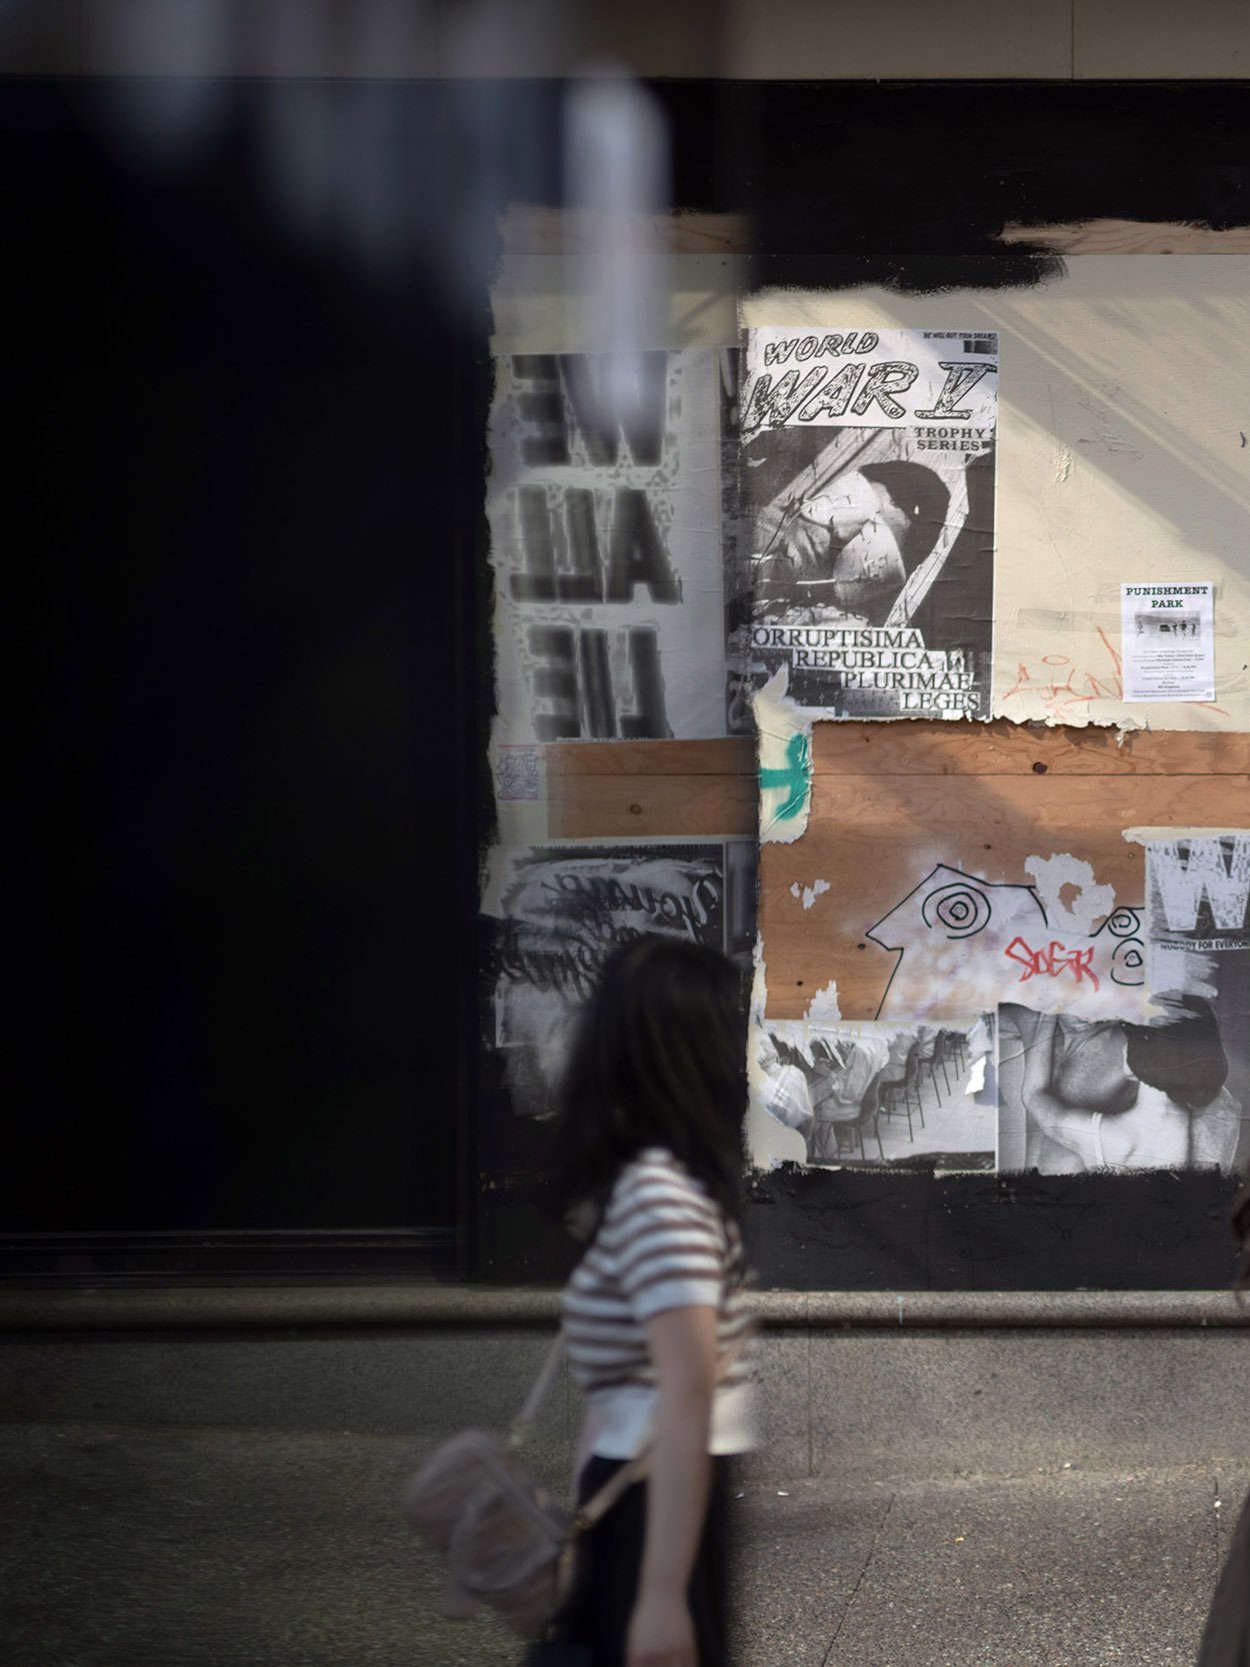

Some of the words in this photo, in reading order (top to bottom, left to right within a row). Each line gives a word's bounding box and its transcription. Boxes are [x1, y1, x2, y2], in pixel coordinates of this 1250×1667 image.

[764, 332, 879, 366] WORLD
[740, 361, 918, 433] WAR
[915, 427, 986, 439] TROPHY
[917, 440, 981, 452] SERIES
[1126, 586, 1208, 595] PUNISHMENT
[1151, 600, 1184, 608] PARK
[753, 628, 924, 648] ORRUPTISIMA
[796, 650, 933, 669] REPUBLICA
[843, 671, 973, 690] PLURIMAE
[902, 692, 980, 711] LEGES
[1199, 941, 1214, 949] FOR
